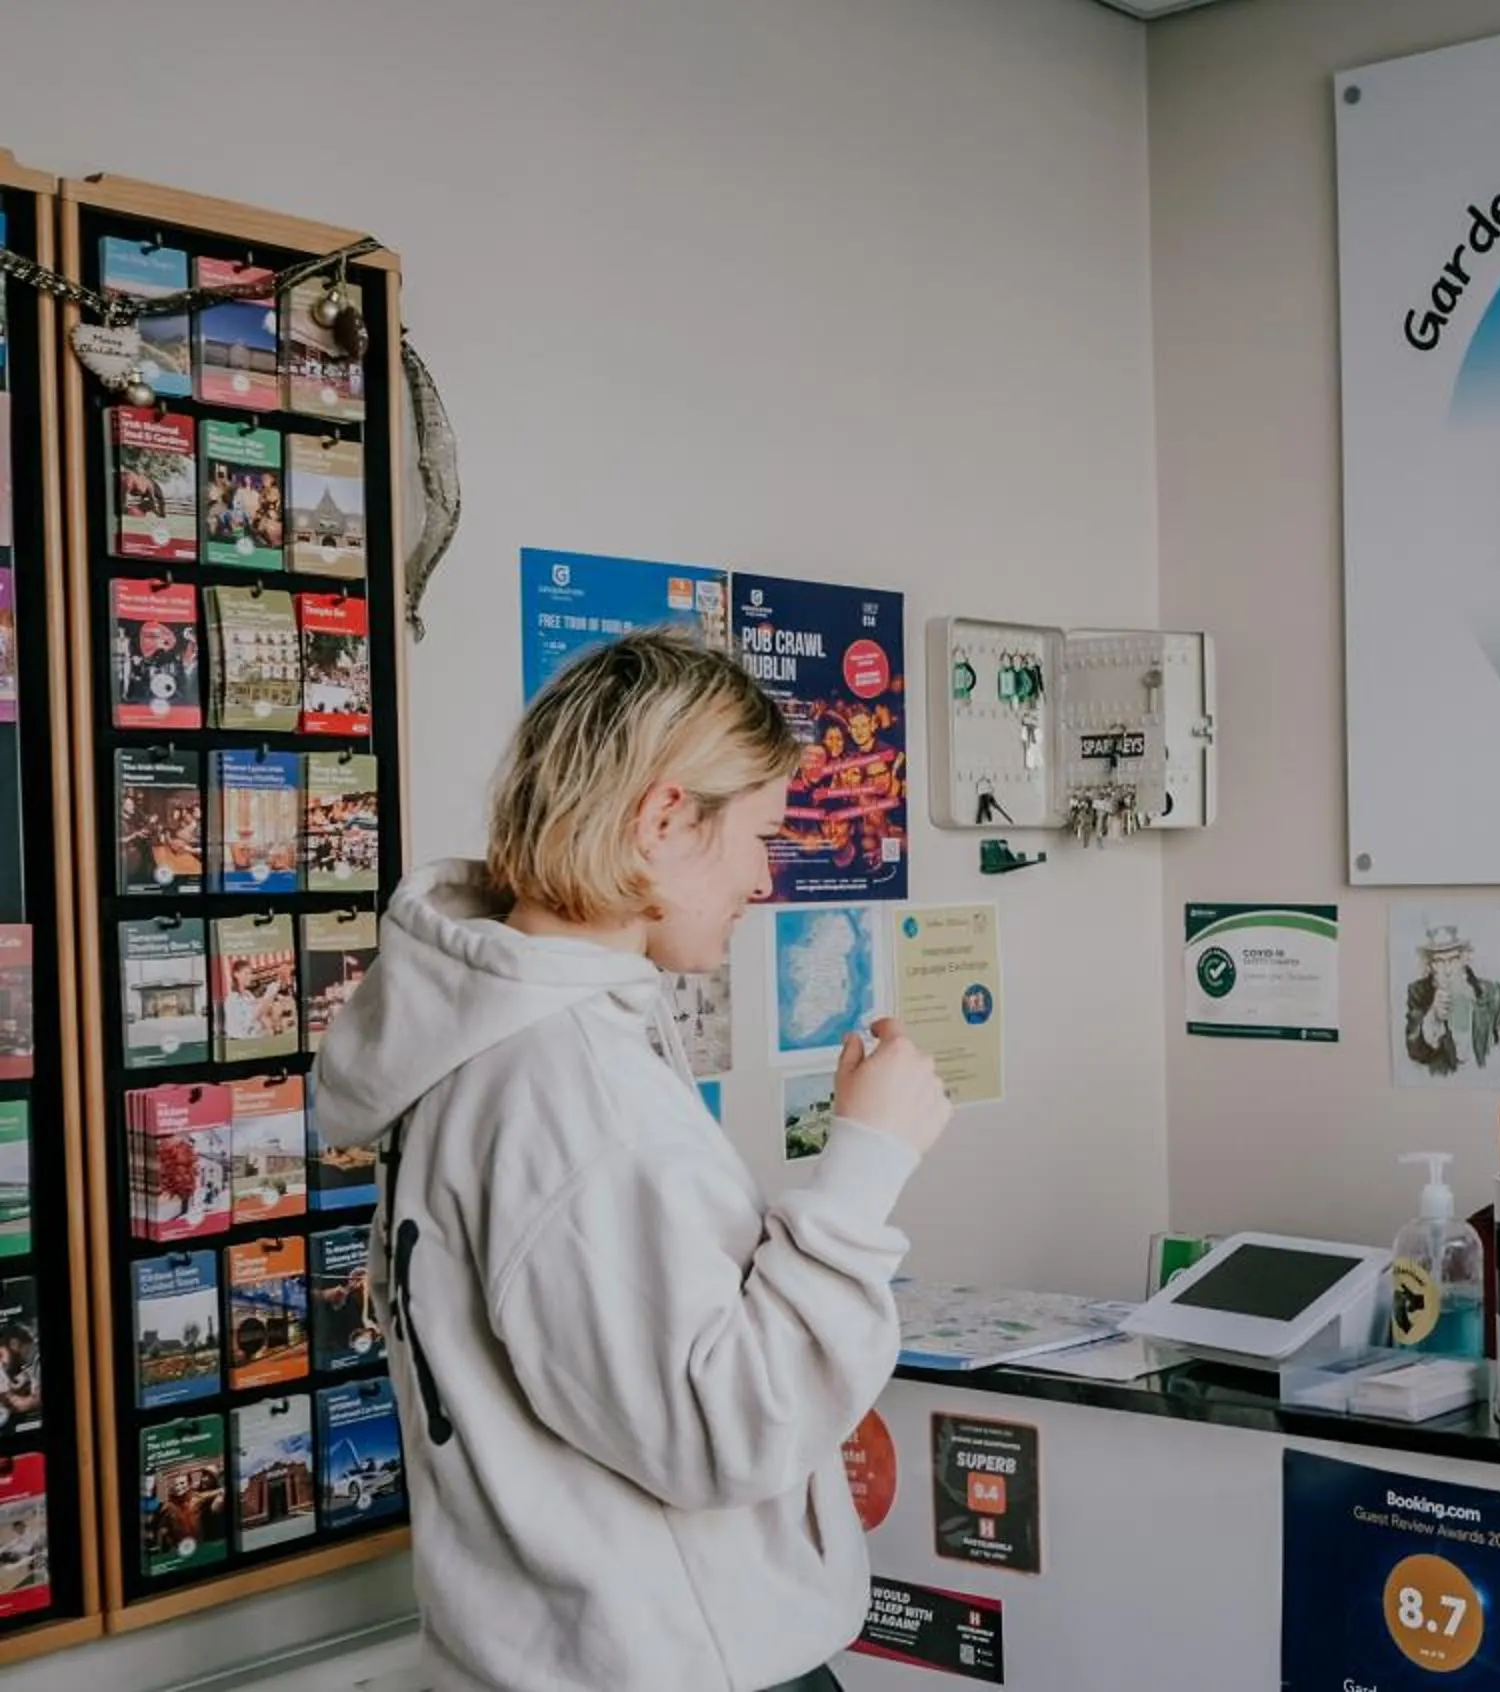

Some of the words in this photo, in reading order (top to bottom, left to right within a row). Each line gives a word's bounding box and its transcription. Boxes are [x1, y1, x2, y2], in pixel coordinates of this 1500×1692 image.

[538, 613, 561, 629] FREE
[742, 626, 773, 652] PUB
[776, 629, 826, 658] CRAWL
[743, 653, 797, 682] DUBLIN
[956, 1450, 1018, 1474] SUPERB
[973, 1482, 999, 1501] 9.4
[1386, 1489, 1482, 1523] Booking.com
[1353, 1505, 1389, 1526] Guest
[1391, 1513, 1435, 1535] Review
[1437, 1523, 1485, 1545] Awards
[873, 1586, 911, 1604] WOULD
[875, 1599, 904, 1615] SLEEP
[905, 1605, 934, 1623] WITH
[1398, 1587, 1468, 1637] 8.7
